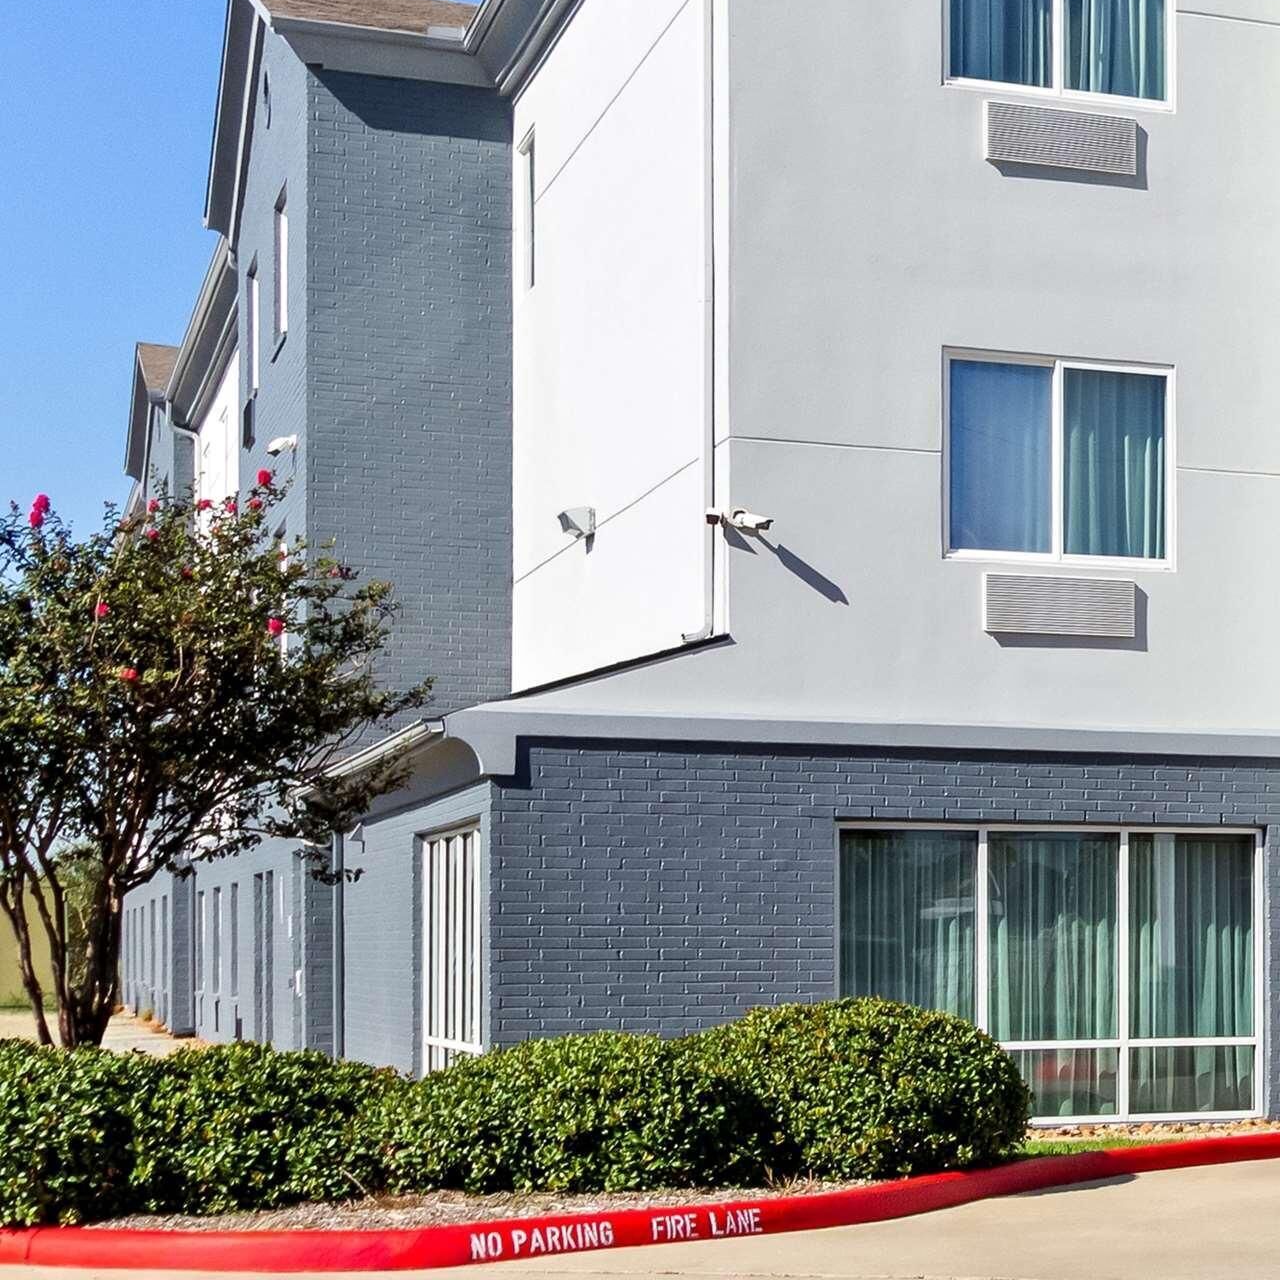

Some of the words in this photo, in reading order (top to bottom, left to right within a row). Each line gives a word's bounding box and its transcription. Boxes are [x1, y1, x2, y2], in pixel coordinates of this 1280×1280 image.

[470, 1233, 503, 1260] NO
[511, 1220, 615, 1254] PARKING
[651, 1213, 698, 1241] FIRE
[708, 1207, 763, 1237] LANE
